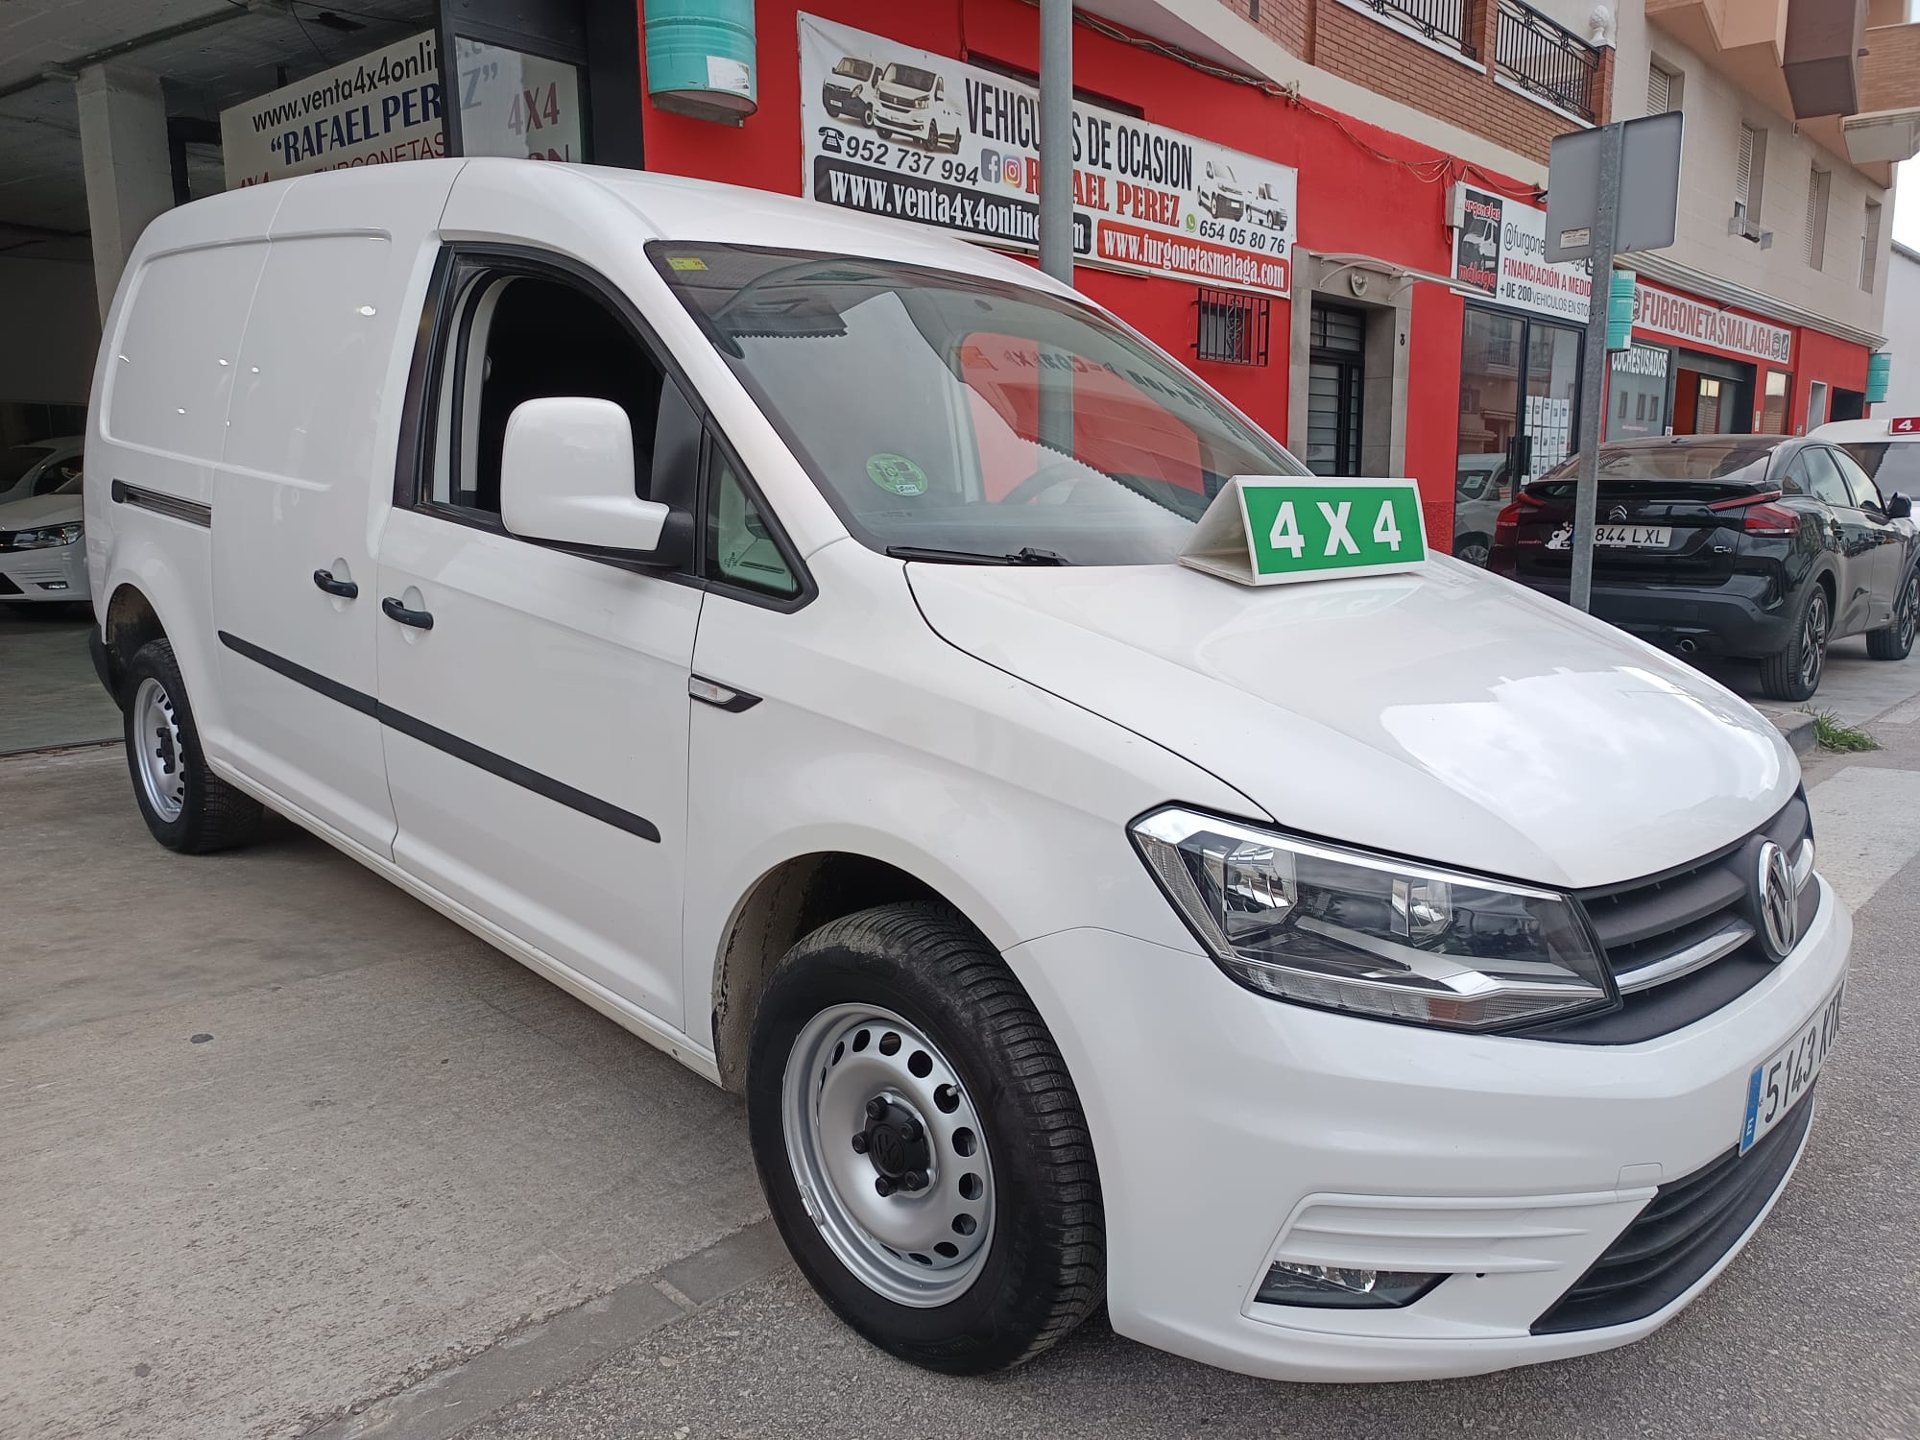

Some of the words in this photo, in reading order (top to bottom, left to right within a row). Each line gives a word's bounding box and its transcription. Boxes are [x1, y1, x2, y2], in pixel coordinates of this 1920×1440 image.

[508, 81, 560, 136] 4X4
[965, 77, 1082, 162] VEHICUS
[1087, 116, 1112, 171] DE
[1117, 126, 1192, 191] OCASION
[845, 135, 889, 166] 952
[896, 147, 935, 176] 737
[941, 159, 979, 186] 994
[1025, 157, 1109, 212] RAEL
[1116, 180, 1181, 228] PEREZ
[1464, 199, 1500, 222] urgonetas
[1103, 228, 1285, 289] www.furgonetasmalaga.com
[1200, 220, 1225, 241] 654
[1229, 227, 1246, 246] 05
[1249, 231, 1266, 251] 80
[1270, 236, 1286, 254] 76
[1503, 257, 1560, 290] FINANCIACIÓN
[1561, 276, 1568, 291] A
[1568, 278, 1592, 298] MEDID
[1506, 282, 1516, 298] DE
[1517, 285, 1532, 303] 200
[1640, 291, 1772, 357] FURGONETASMALAGA
[1897, 419, 1913, 431] 4
[1269, 501, 1306, 559] 4
[1315, 501, 1361, 557] X
[1372, 499, 1402, 552] 4
[1595, 527, 1626, 543] 844
[1632, 528, 1665, 544] LXL
[1765, 1025, 1817, 1124] 5143
